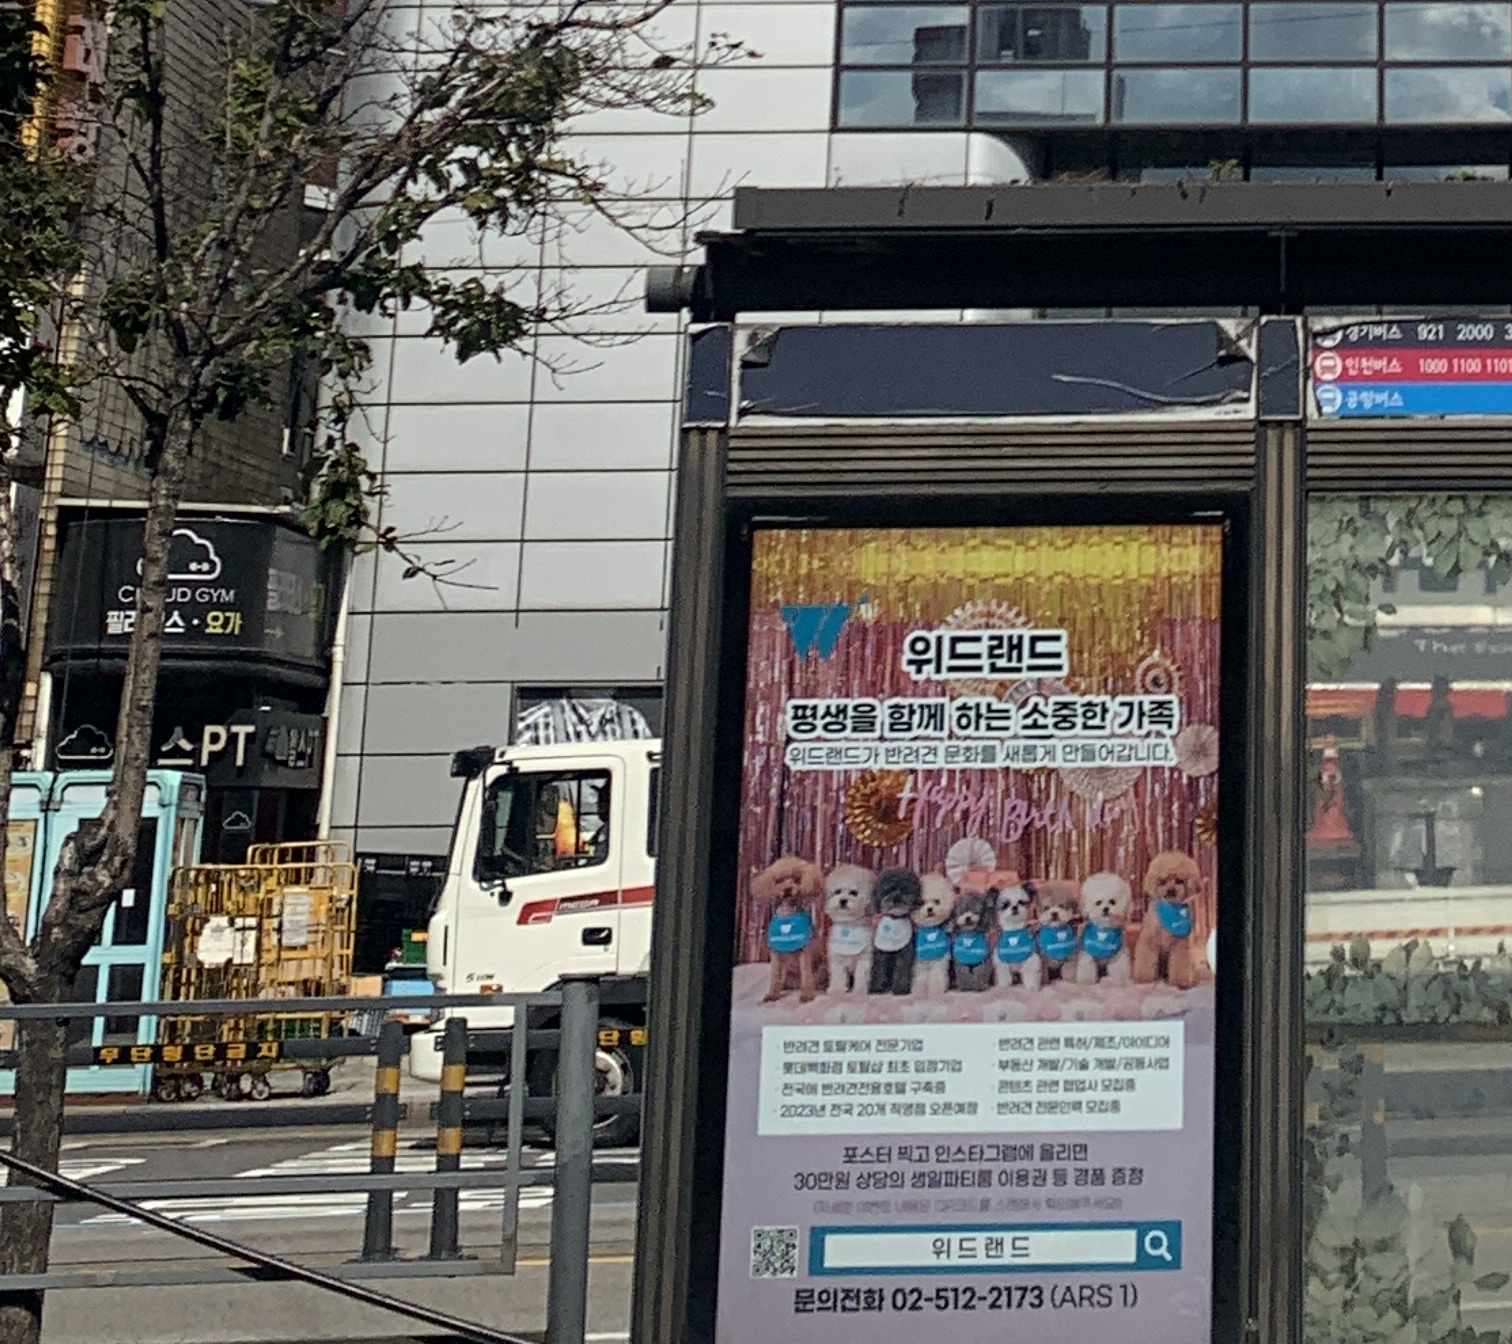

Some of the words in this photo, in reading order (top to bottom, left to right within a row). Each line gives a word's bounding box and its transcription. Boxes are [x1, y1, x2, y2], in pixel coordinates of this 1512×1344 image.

[1457, 323, 1494, 341] 2000
[118, 585, 192, 603] CUD
[196, 587, 235, 603] GYM
[106, 610, 186, 635] 필스
[204, 611, 243, 635] 요가
[905, 634, 1065, 674] 위드랜드
[790, 703, 878, 734] 평생을
[888, 702, 946, 733] 함께
[955, 701, 1011, 731] 하는
[1022, 700, 1110, 731] 소중한
[1119, 700, 1176, 730] 가족
[789, 745, 879, 765] 위드랜드가
[885, 745, 938, 765] 반려견
[944, 744, 997, 764] 문화를
[1003, 743, 1057, 764] 새롭게
[842, 1145, 893, 1164] 포스터
[935, 1143, 1034, 1163] 인스타그램에
[794, 1171, 851, 1191] 30만원
[856, 1170, 905, 1190] 상당의
[998, 1168, 1047, 1188] 이용권
[794, 1287, 885, 1313] 문의전화
[891, 1285, 1044, 1311] 02-512-2173
[1051, 1284, 1112, 1310] (ARS
